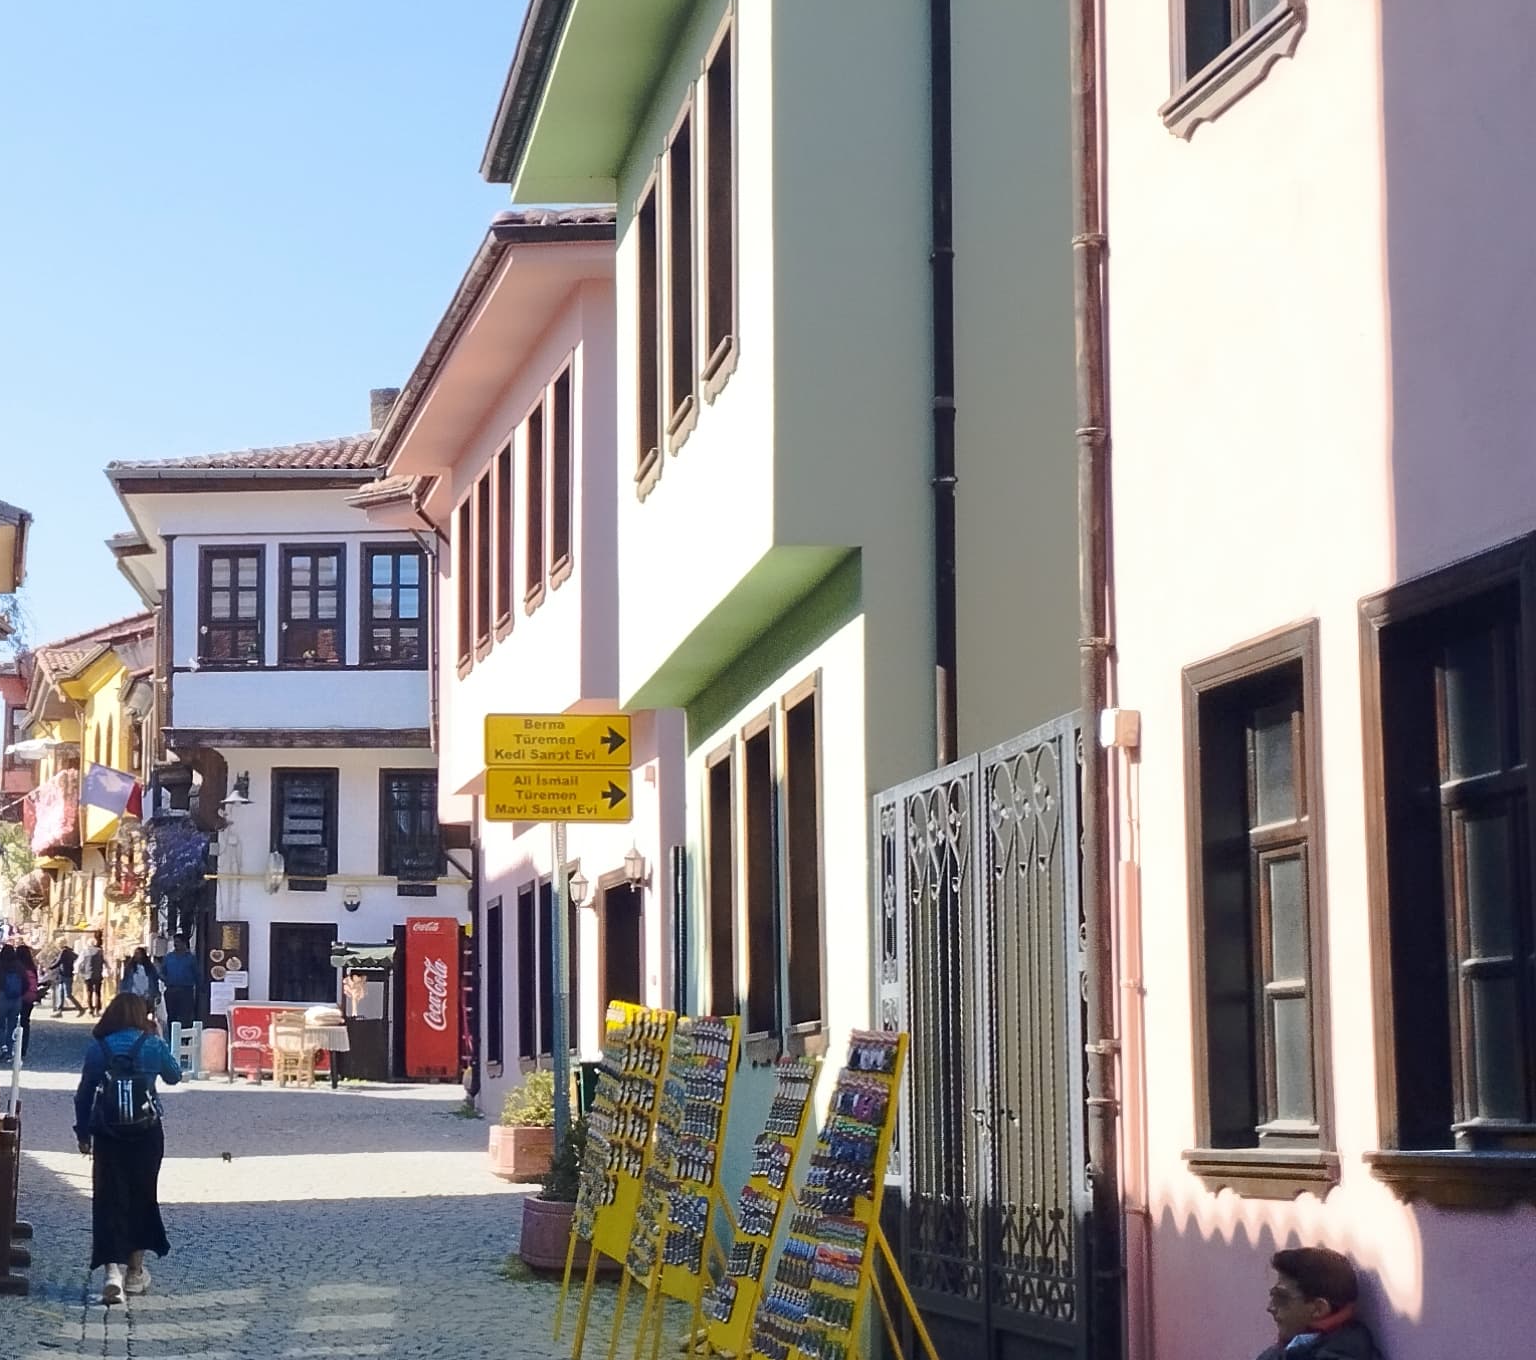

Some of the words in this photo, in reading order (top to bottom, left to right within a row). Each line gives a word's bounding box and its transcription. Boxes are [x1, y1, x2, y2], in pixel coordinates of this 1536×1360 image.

[524, 719, 565, 730] Berna
[514, 734, 576, 745] Türemen
[494, 749, 525, 760] Kedi
[530, 749, 571, 761] Sanat
[575, 749, 596, 760] Evi
[513, 775, 531, 786] Ali
[516, 790, 577, 801] Türemen
[495, 804, 527, 815] Mavi
[532, 804, 572, 815] Sanat
[577, 804, 598, 815] Evi
